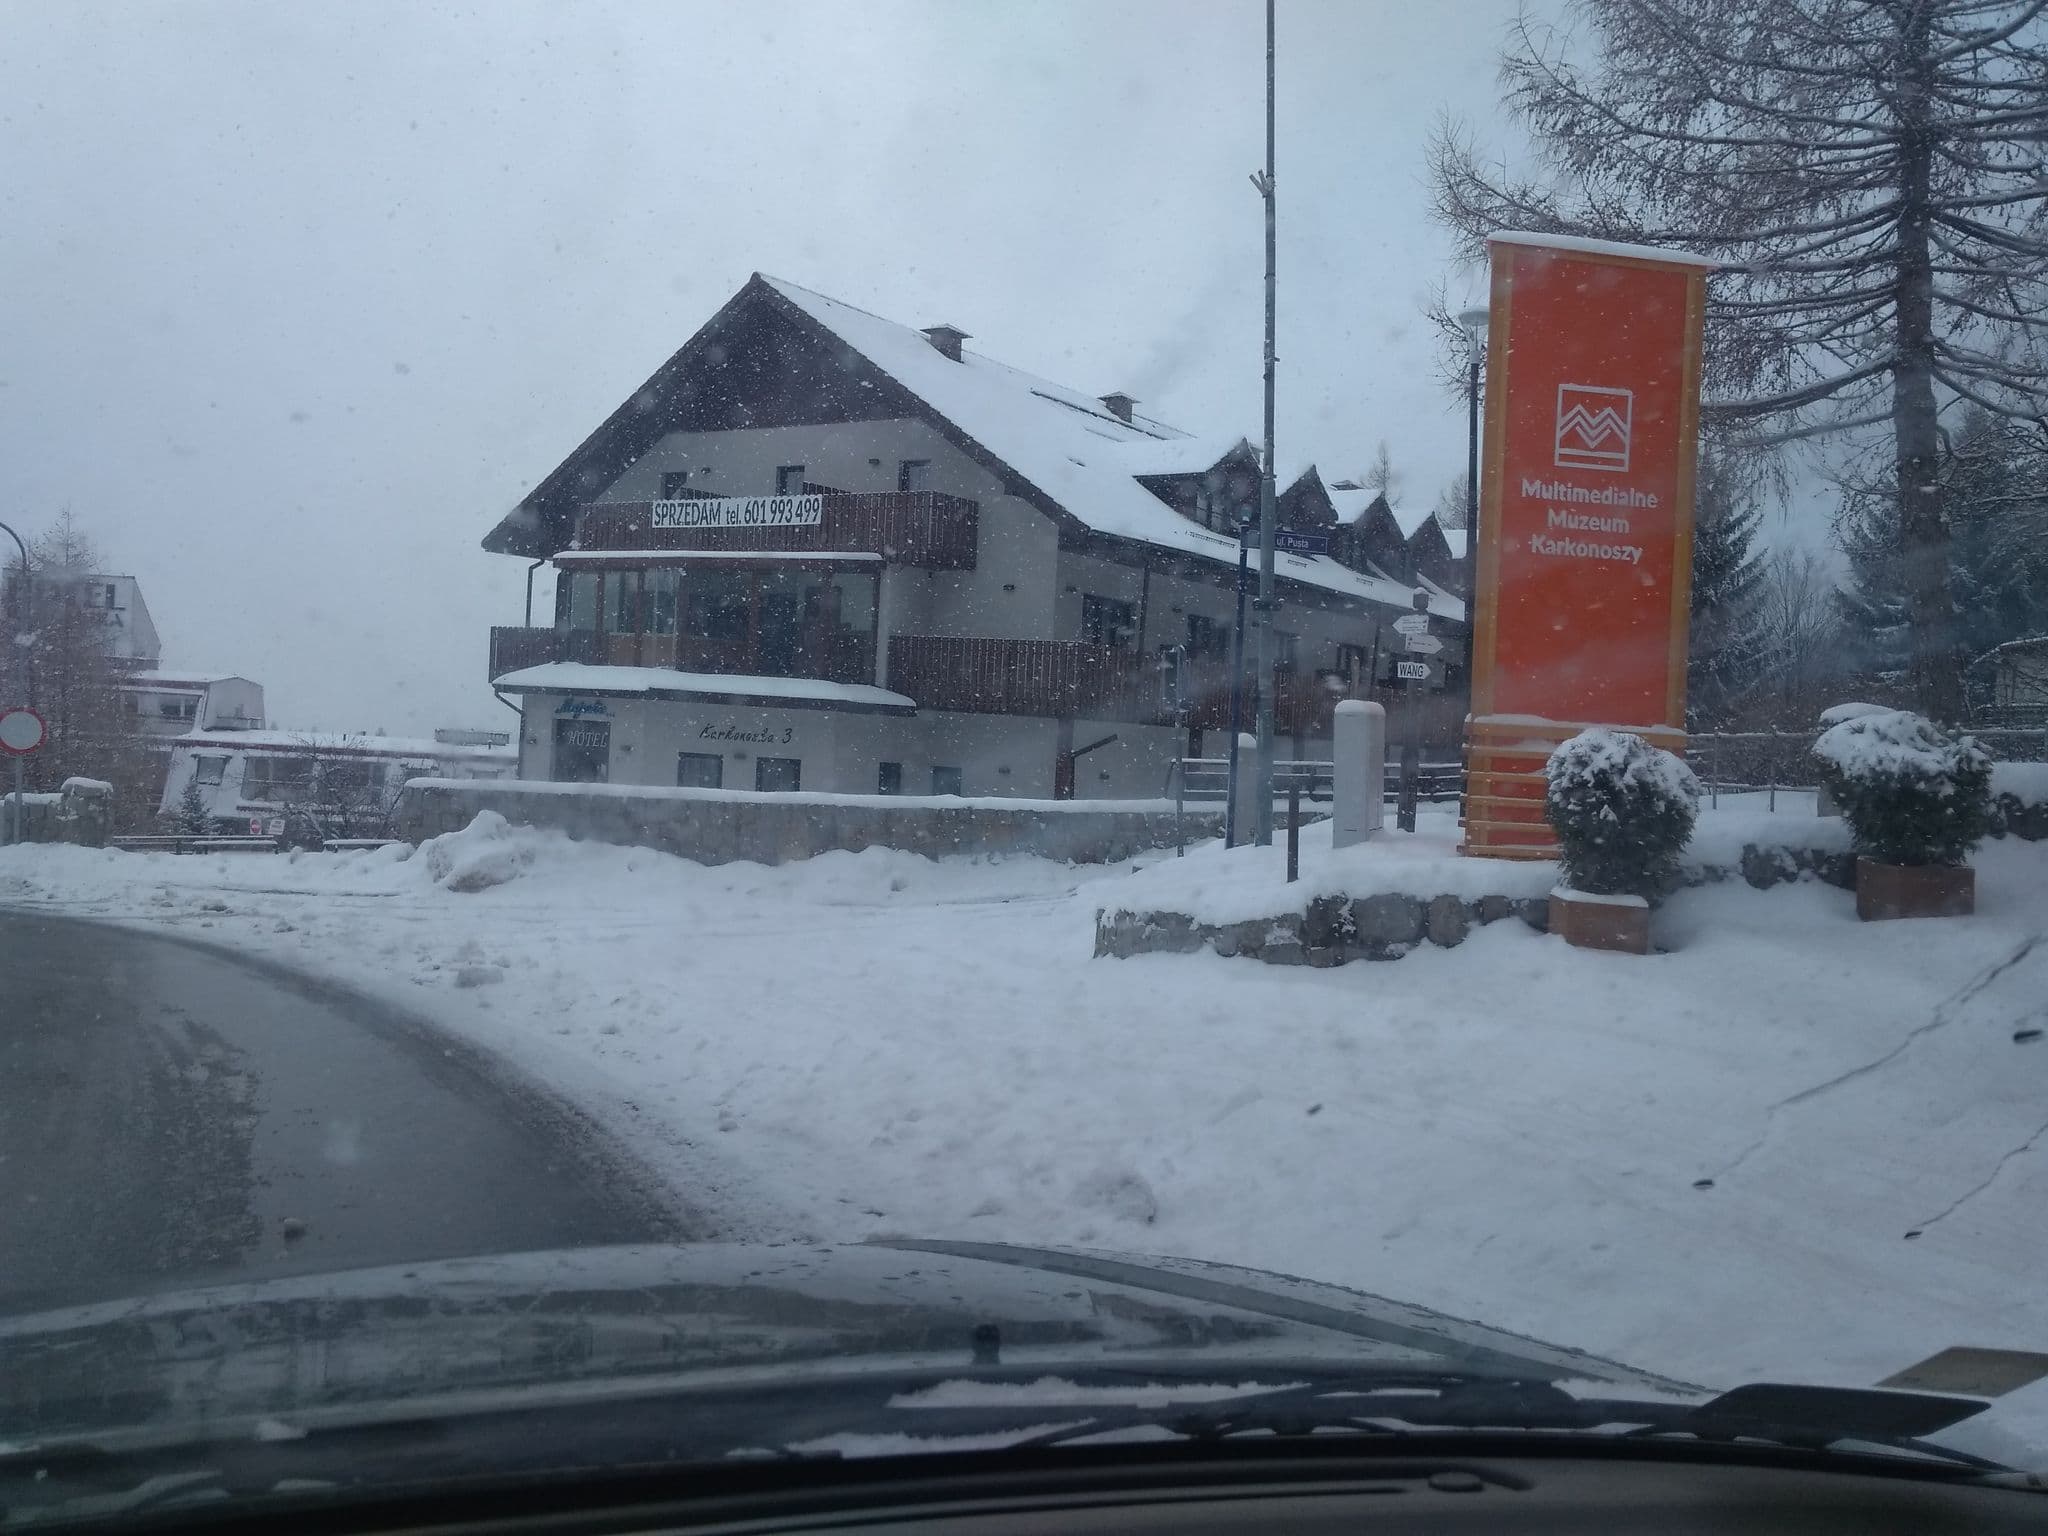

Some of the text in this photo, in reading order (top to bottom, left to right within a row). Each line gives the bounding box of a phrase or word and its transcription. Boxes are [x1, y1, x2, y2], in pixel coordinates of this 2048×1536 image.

[1521, 478, 1658, 508] Multimedialne
[654, 497, 820, 526] SPRZEDAM tel. 601 993 499
[1547, 508, 1630, 533] Muzeum
[1287, 537, 1309, 549] Pusta
[1531, 533, 1643, 564] Karkonoszy
[1399, 663, 1424, 677] WANG
[568, 730, 608, 748] HOTEL
[782, 728, 793, 744] 3
